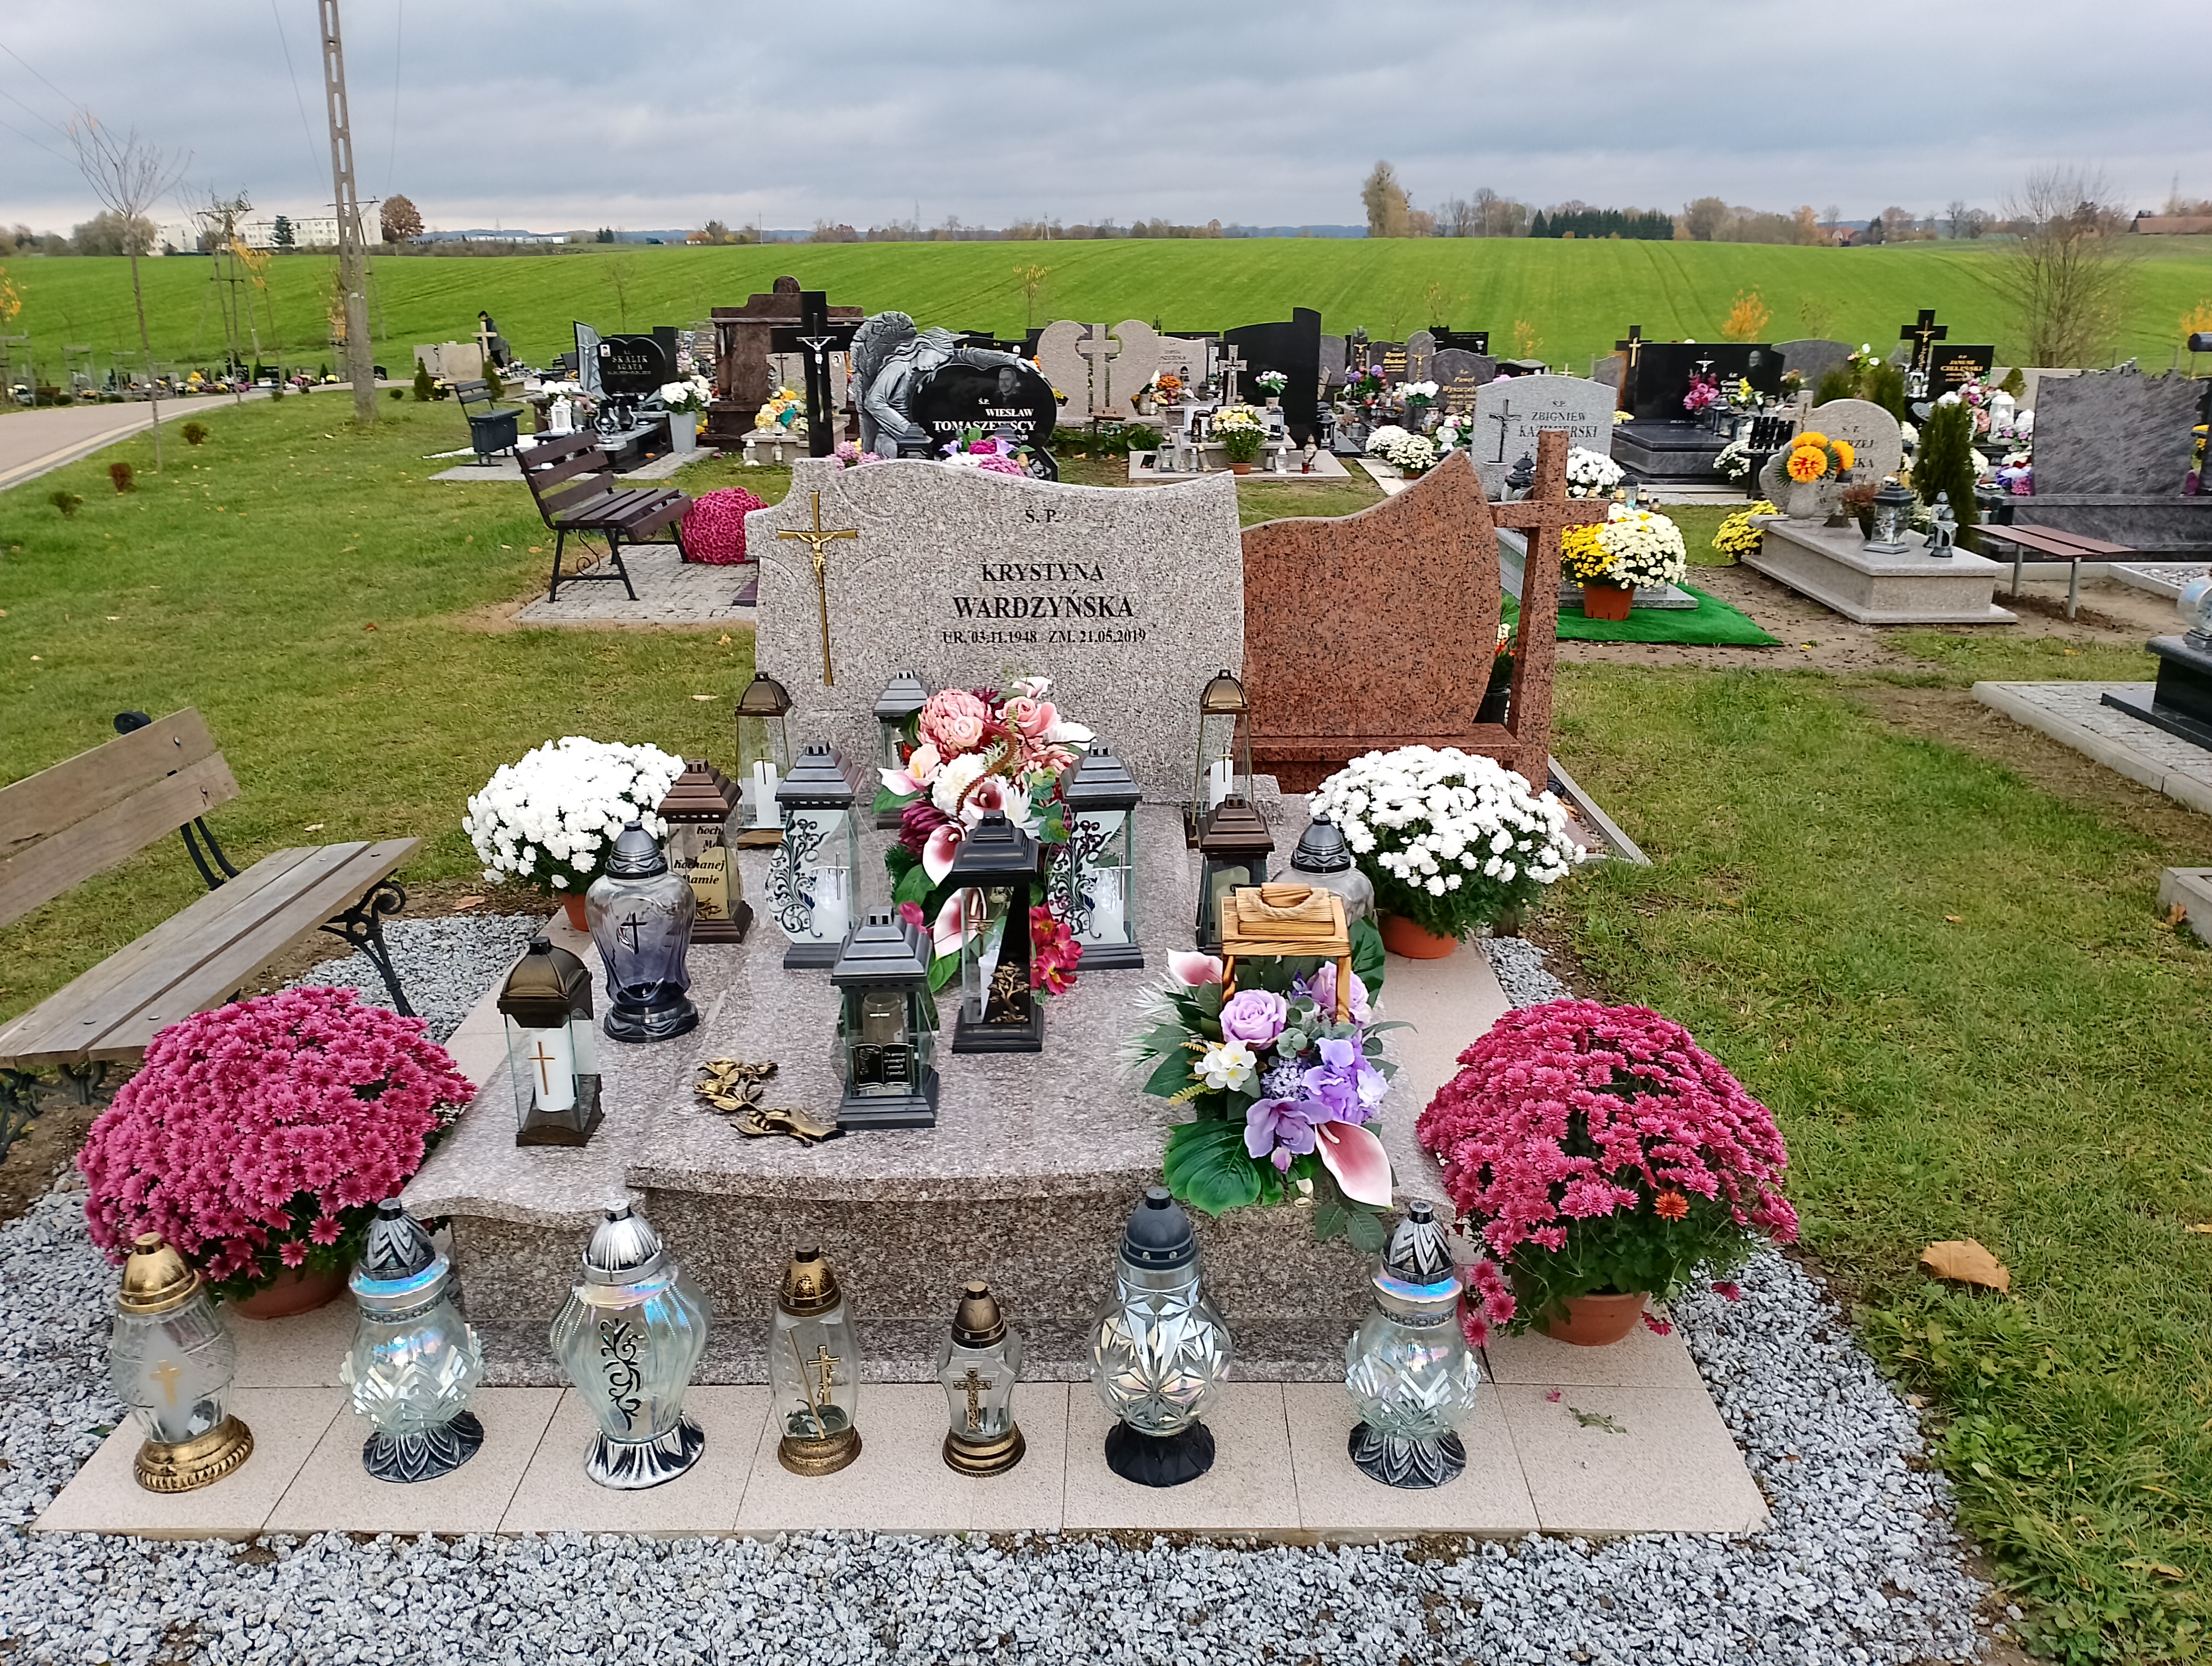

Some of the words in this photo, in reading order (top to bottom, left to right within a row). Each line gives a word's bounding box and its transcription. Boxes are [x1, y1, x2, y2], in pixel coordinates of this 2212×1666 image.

[985, 408, 1034, 417] WIESŁAW
[932, 420, 1037, 431] TOMASZESCY
[981, 563, 1104, 582] KRYSTYNA
[953, 589, 1134, 619] WARDZYŃSKA
[943, 630, 967, 644] UR.
[971, 630, 1037, 644] 03.11.1948
[1049, 630, 1076, 643] ZM.
[1079, 628, 1147, 644] 21.05.2019
